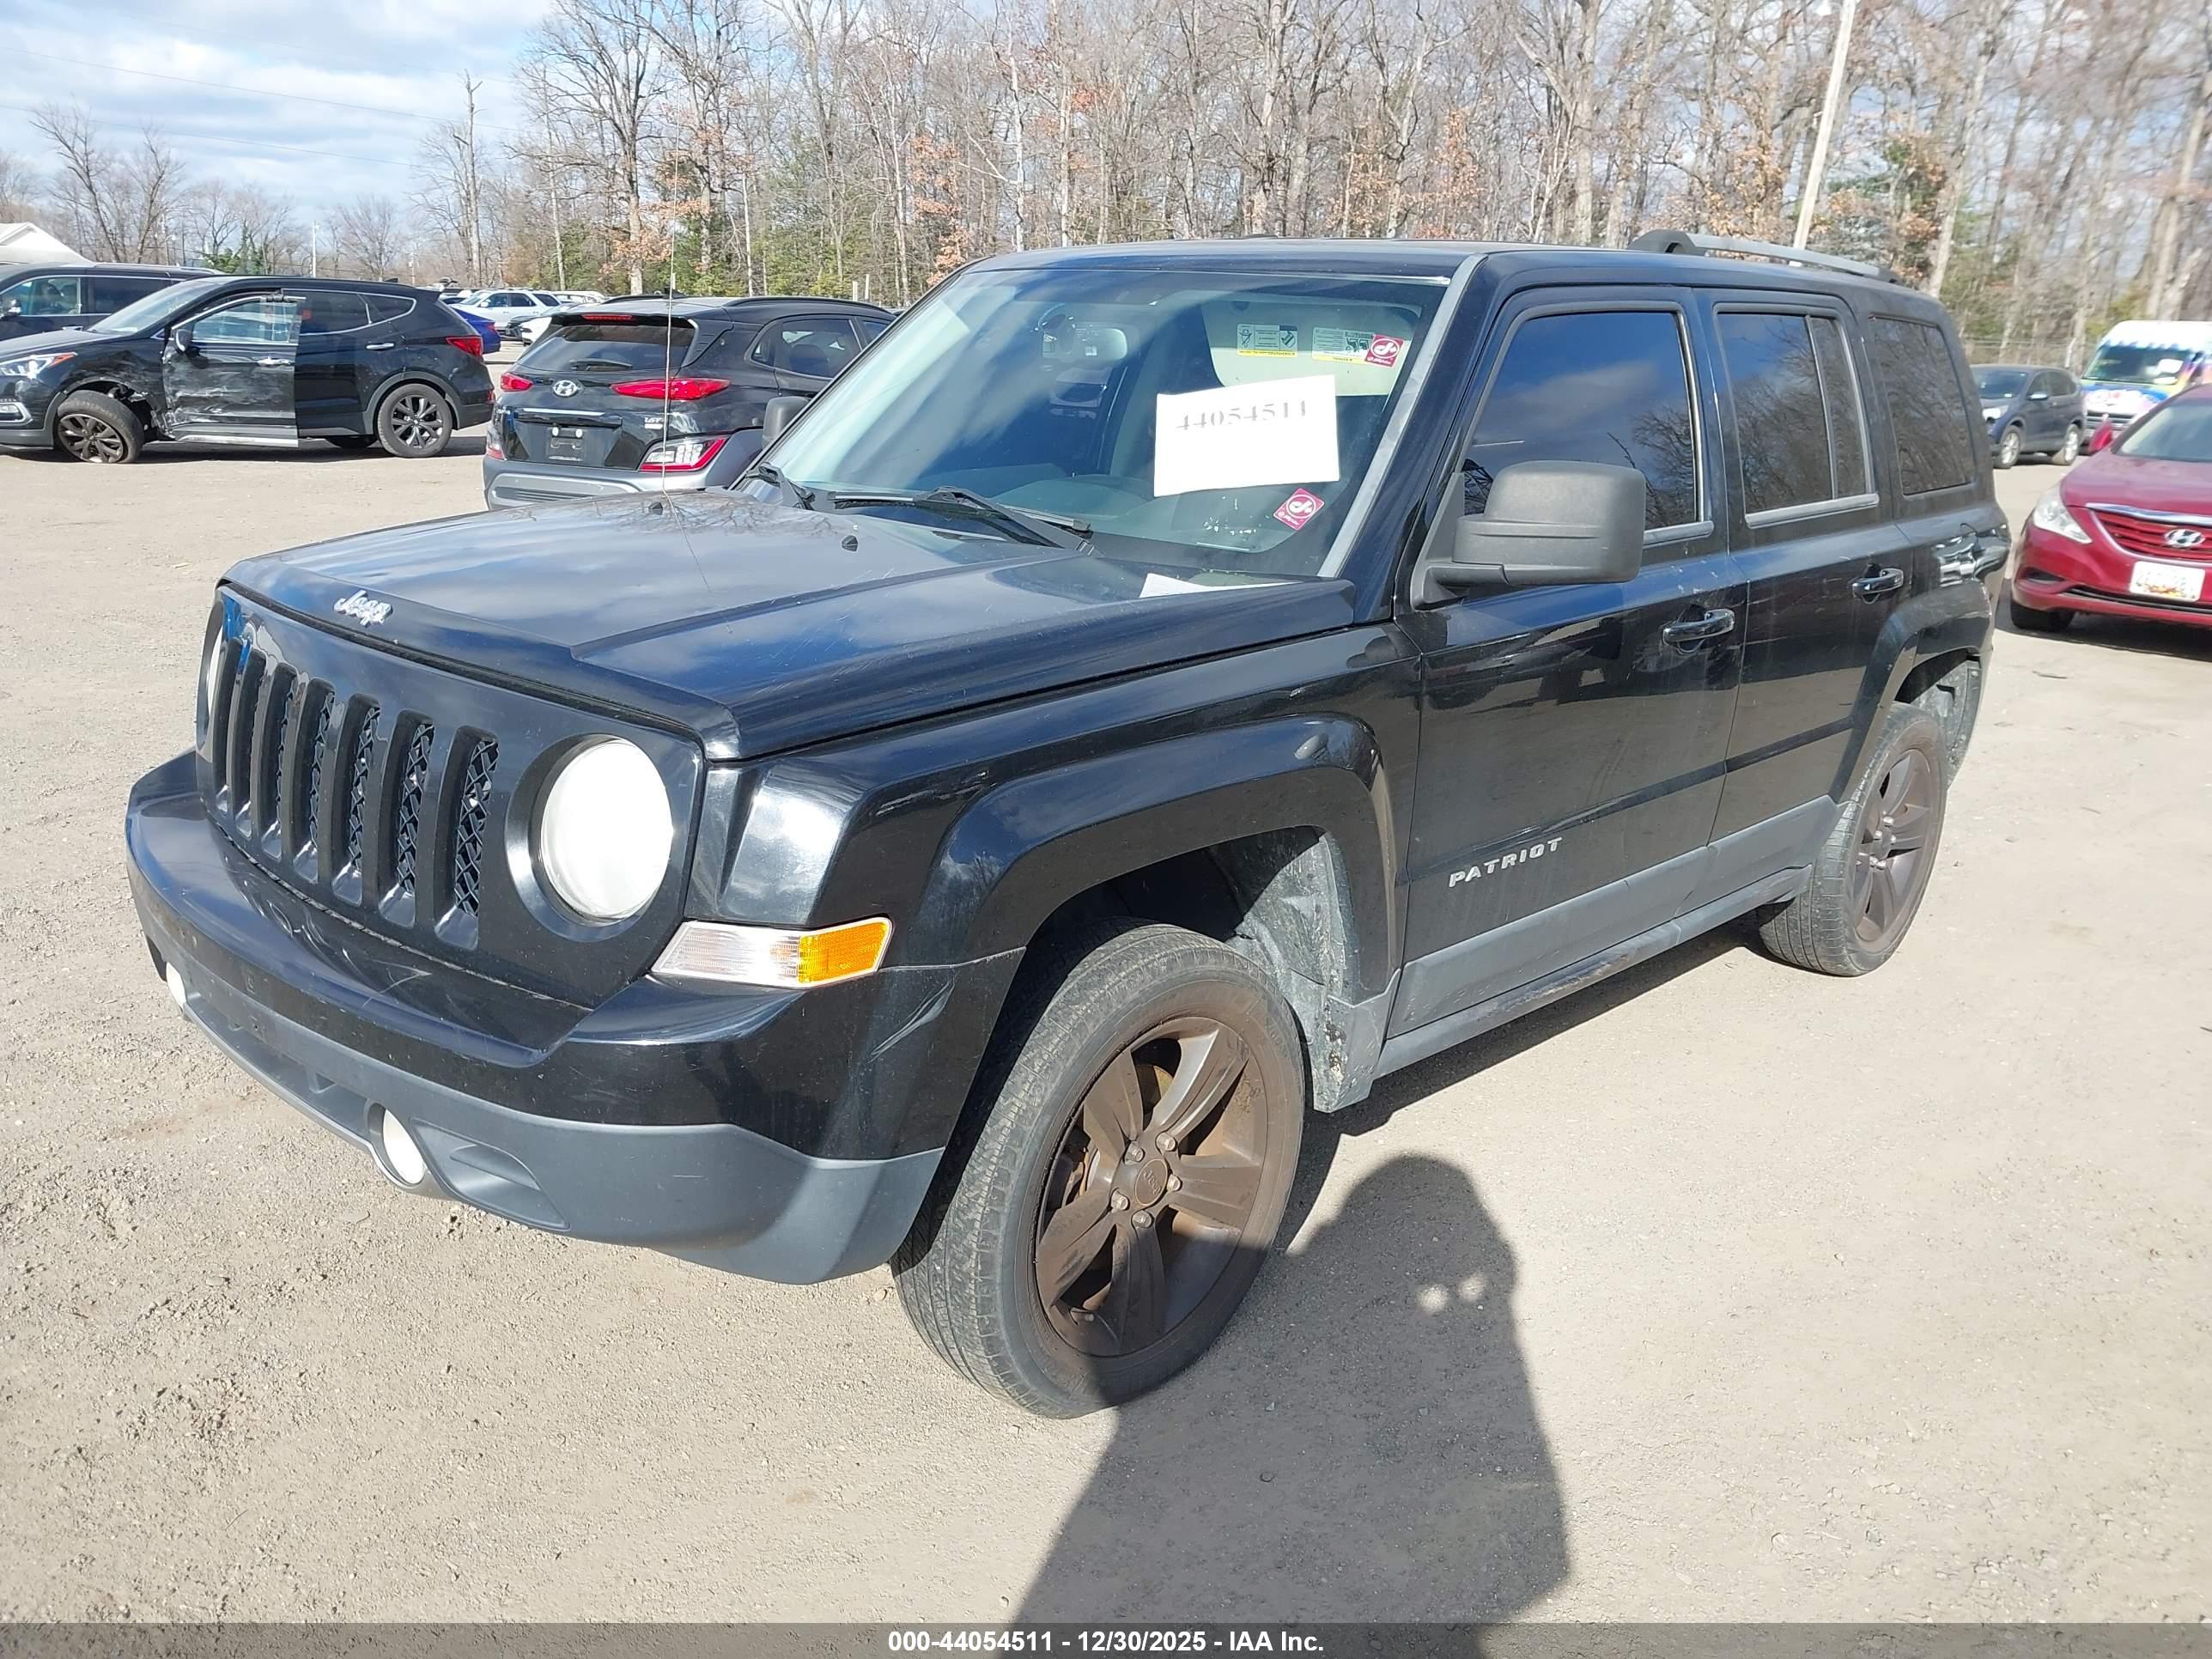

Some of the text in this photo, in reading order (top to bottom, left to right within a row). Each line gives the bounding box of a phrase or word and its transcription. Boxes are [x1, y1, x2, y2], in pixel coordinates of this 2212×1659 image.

[1176, 400, 1306, 431] 44054511
[334, 589, 392, 627] Jeep
[1449, 836, 1564, 888] PATRIOT
